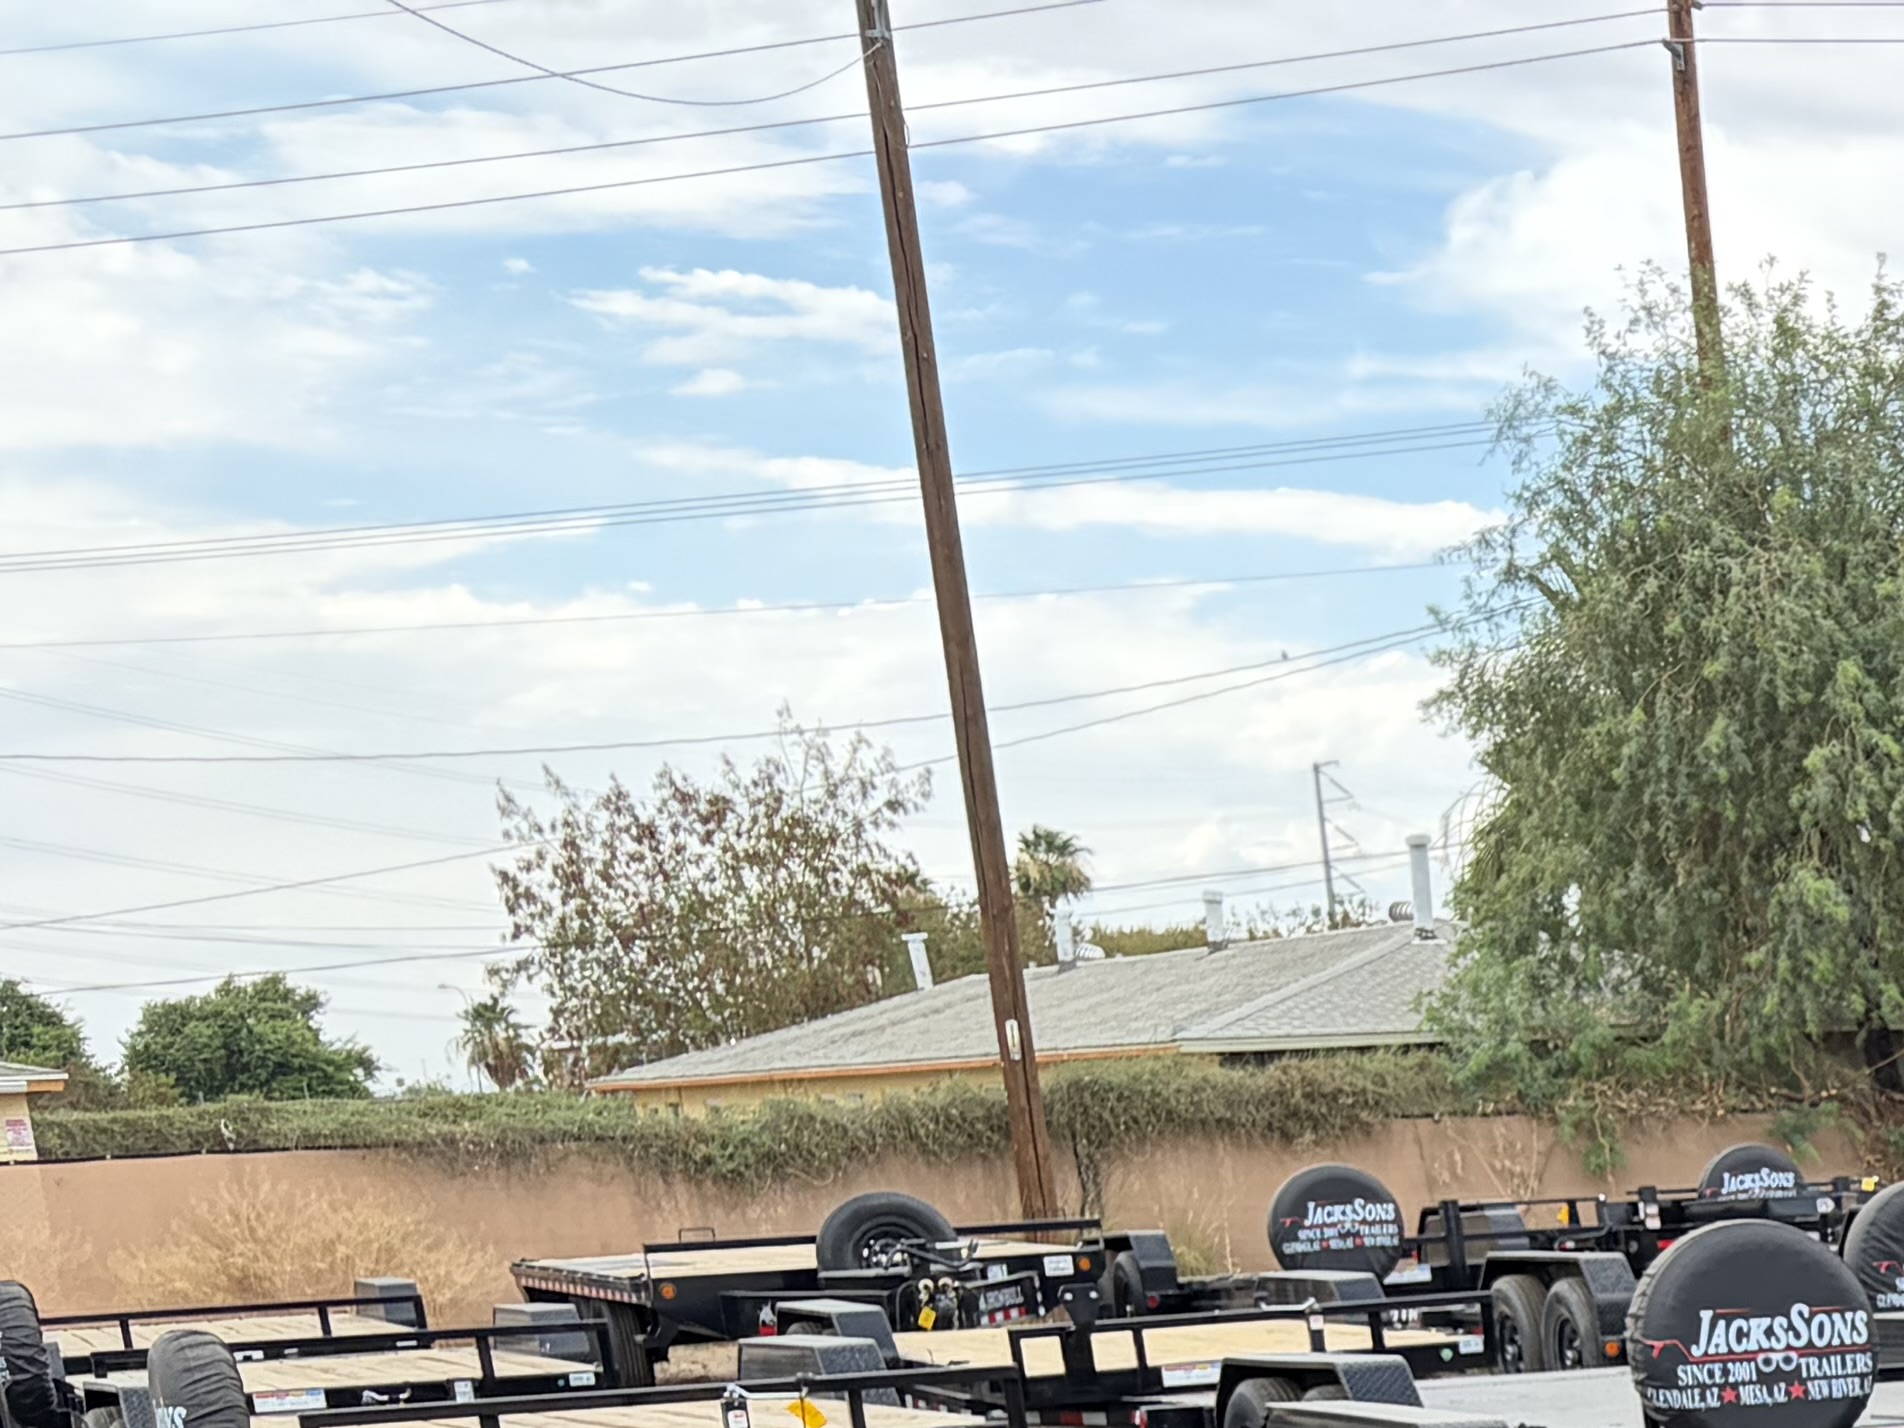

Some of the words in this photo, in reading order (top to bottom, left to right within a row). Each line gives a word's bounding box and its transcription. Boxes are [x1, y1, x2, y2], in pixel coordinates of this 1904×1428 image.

[1677, 1362, 1725, 1388] SINCE
[1728, 1360, 1757, 1384] 2001
[1799, 1352, 1873, 1379] TRAILERS
